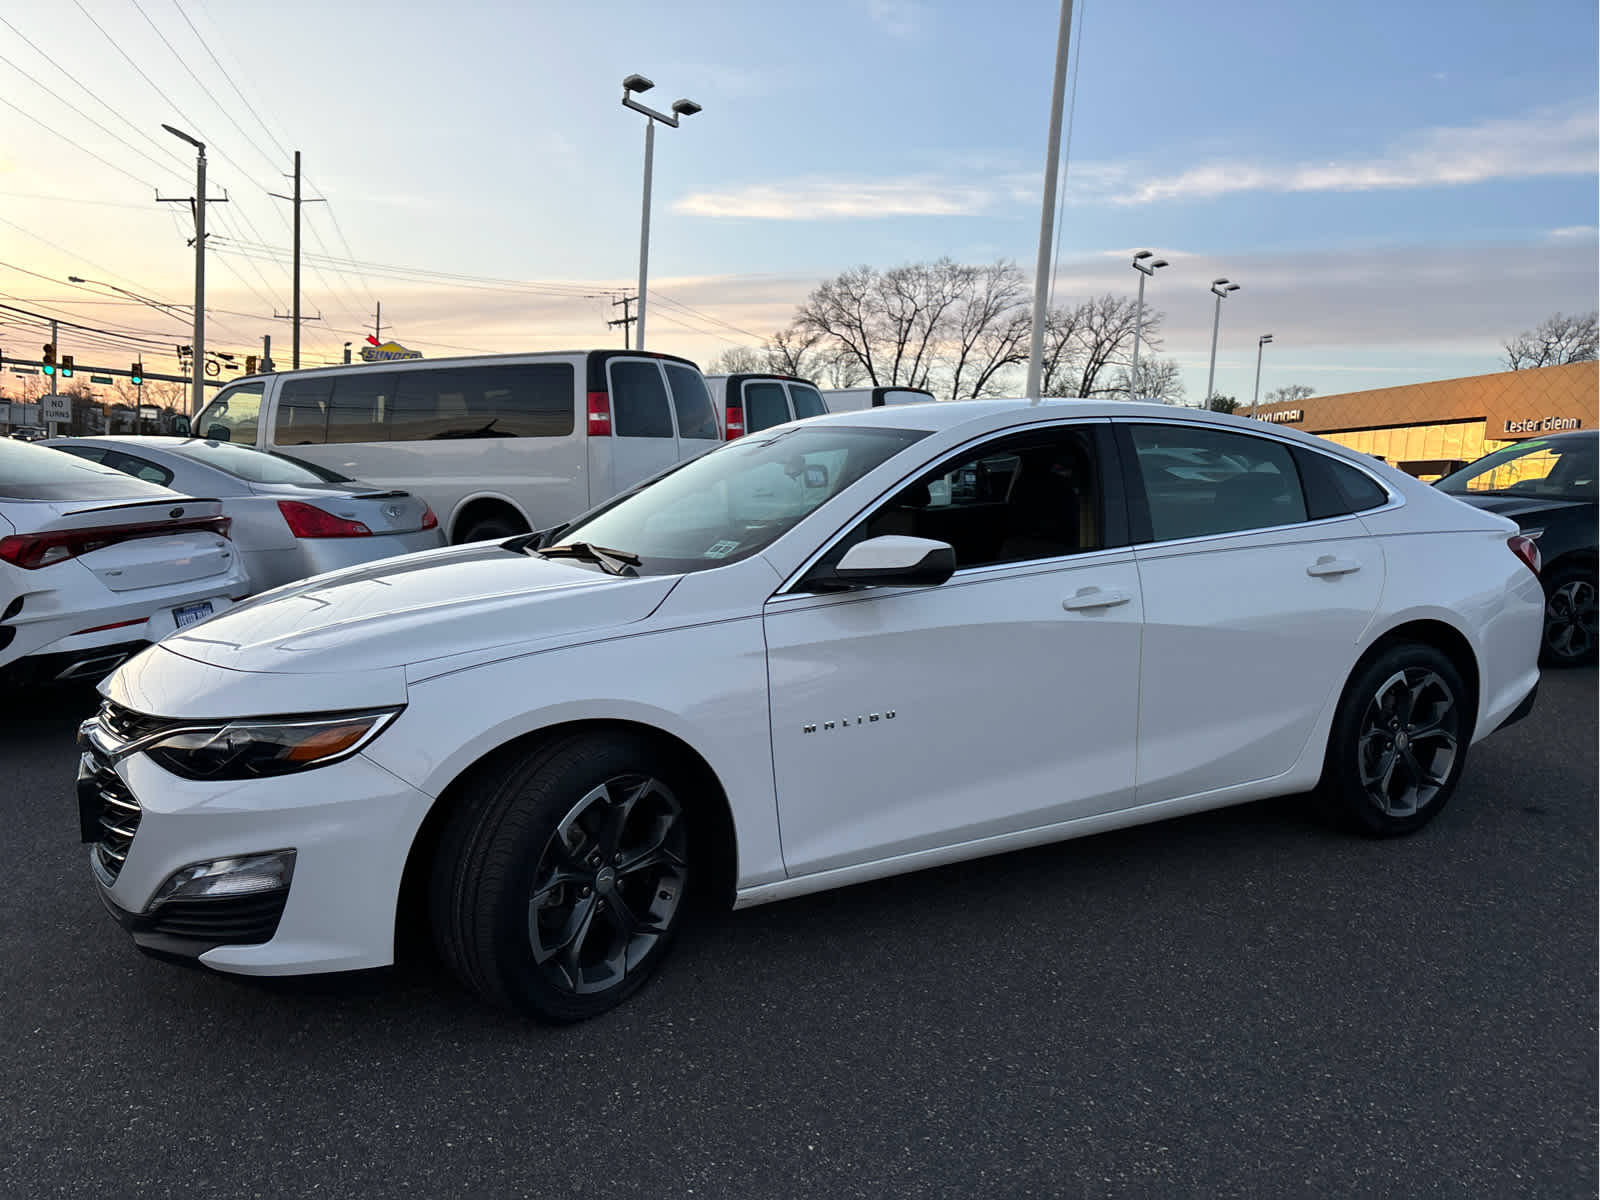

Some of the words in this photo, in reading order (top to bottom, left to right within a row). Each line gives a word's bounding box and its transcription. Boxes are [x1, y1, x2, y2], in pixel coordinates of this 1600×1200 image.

[51, 400, 64, 408] NO
[45, 410, 70, 418] TURNS
[1257, 409, 1301, 423] HYUNDAI
[1503, 418, 1539, 433] Lester
[1542, 415, 1578, 430] Glenn
[803, 709, 896, 734] MALIBU
